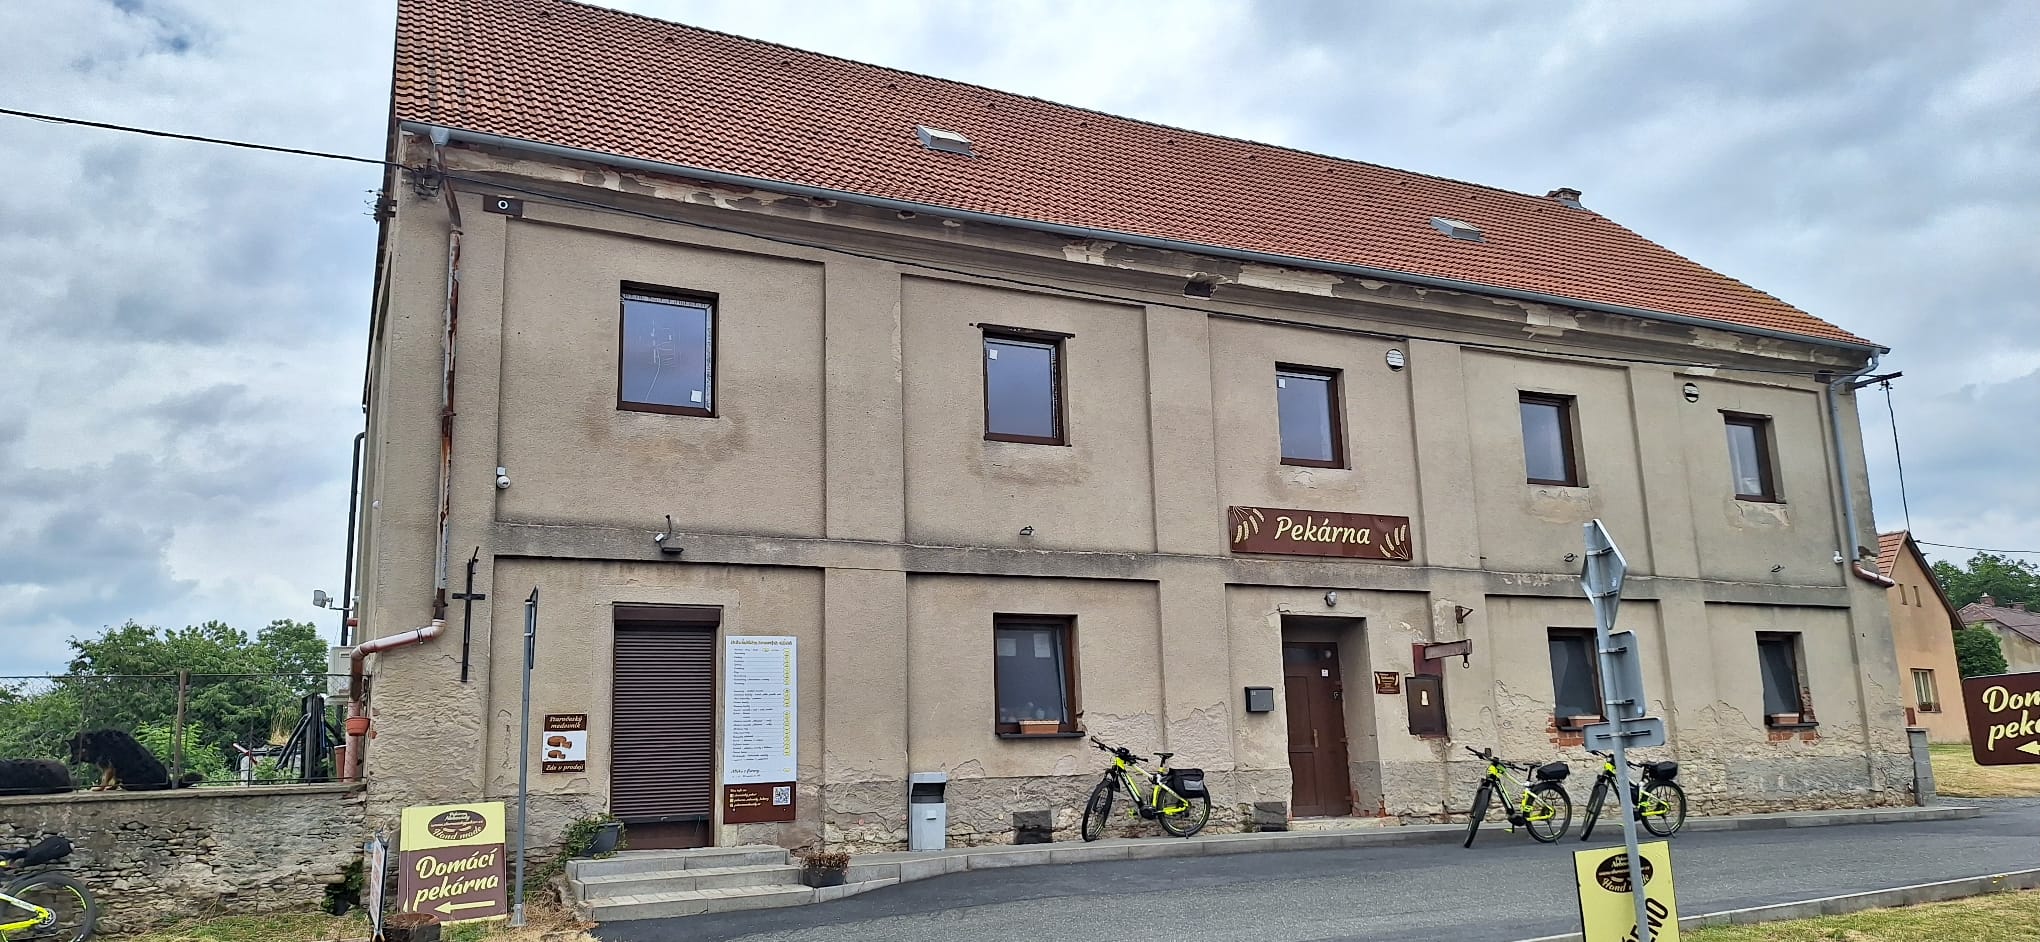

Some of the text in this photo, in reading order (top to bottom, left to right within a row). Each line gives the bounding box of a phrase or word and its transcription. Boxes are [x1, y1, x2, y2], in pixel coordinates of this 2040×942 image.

[1274, 516, 1371, 545] Pekárna
[415, 847, 498, 879] Domácí
[412, 874, 499, 912] pekárna
